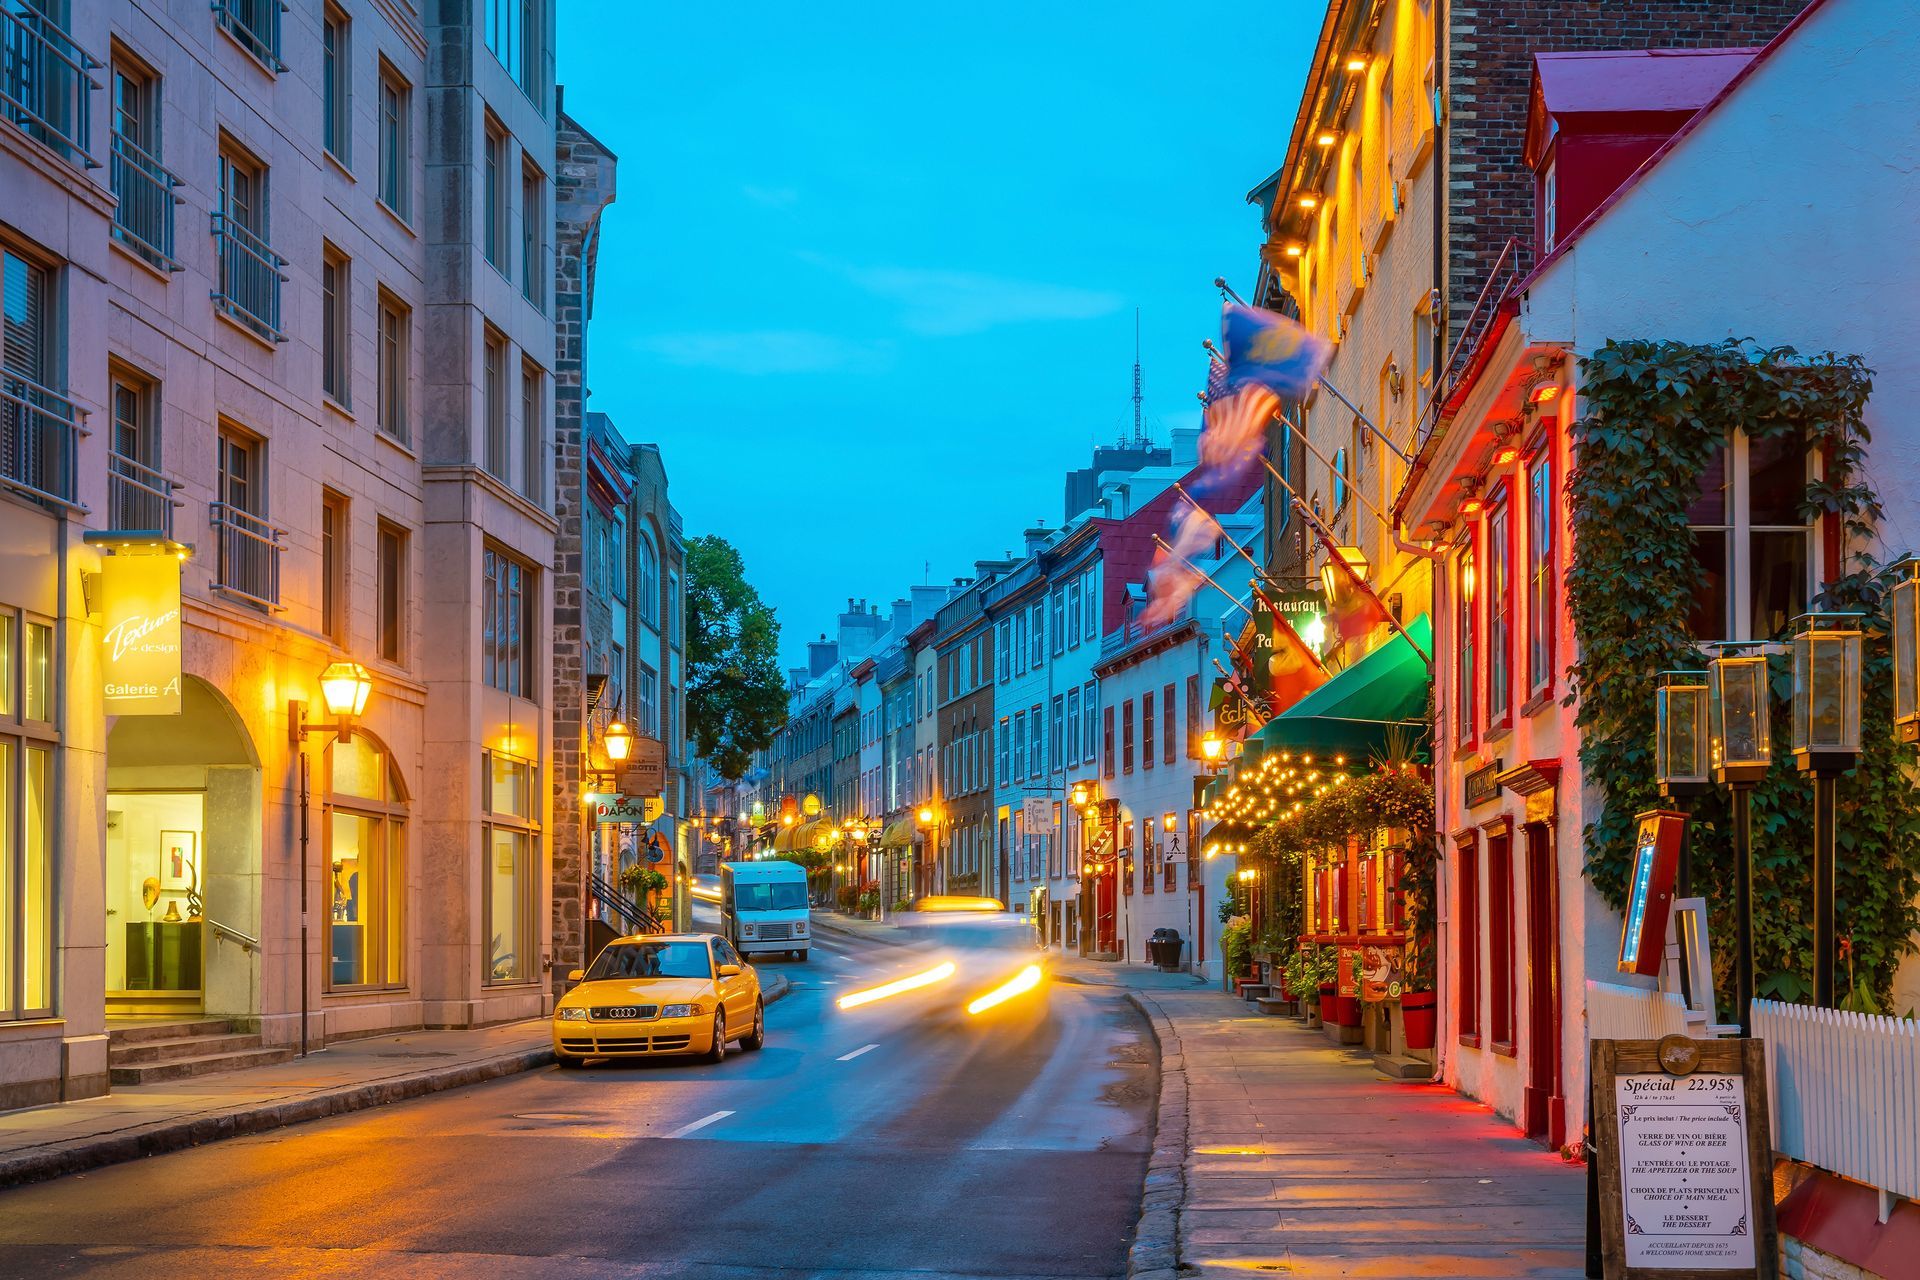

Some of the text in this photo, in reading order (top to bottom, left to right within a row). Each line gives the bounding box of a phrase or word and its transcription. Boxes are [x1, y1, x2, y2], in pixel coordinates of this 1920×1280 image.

[103, 608, 179, 662] Textures
[141, 643, 178, 653] design
[104, 676, 180, 695] Galerie A
[1220, 699, 1272, 724] Eclie
[598, 805, 643, 816] JAPON
[1624, 1078, 1734, 1094] Spécial 22.95$
